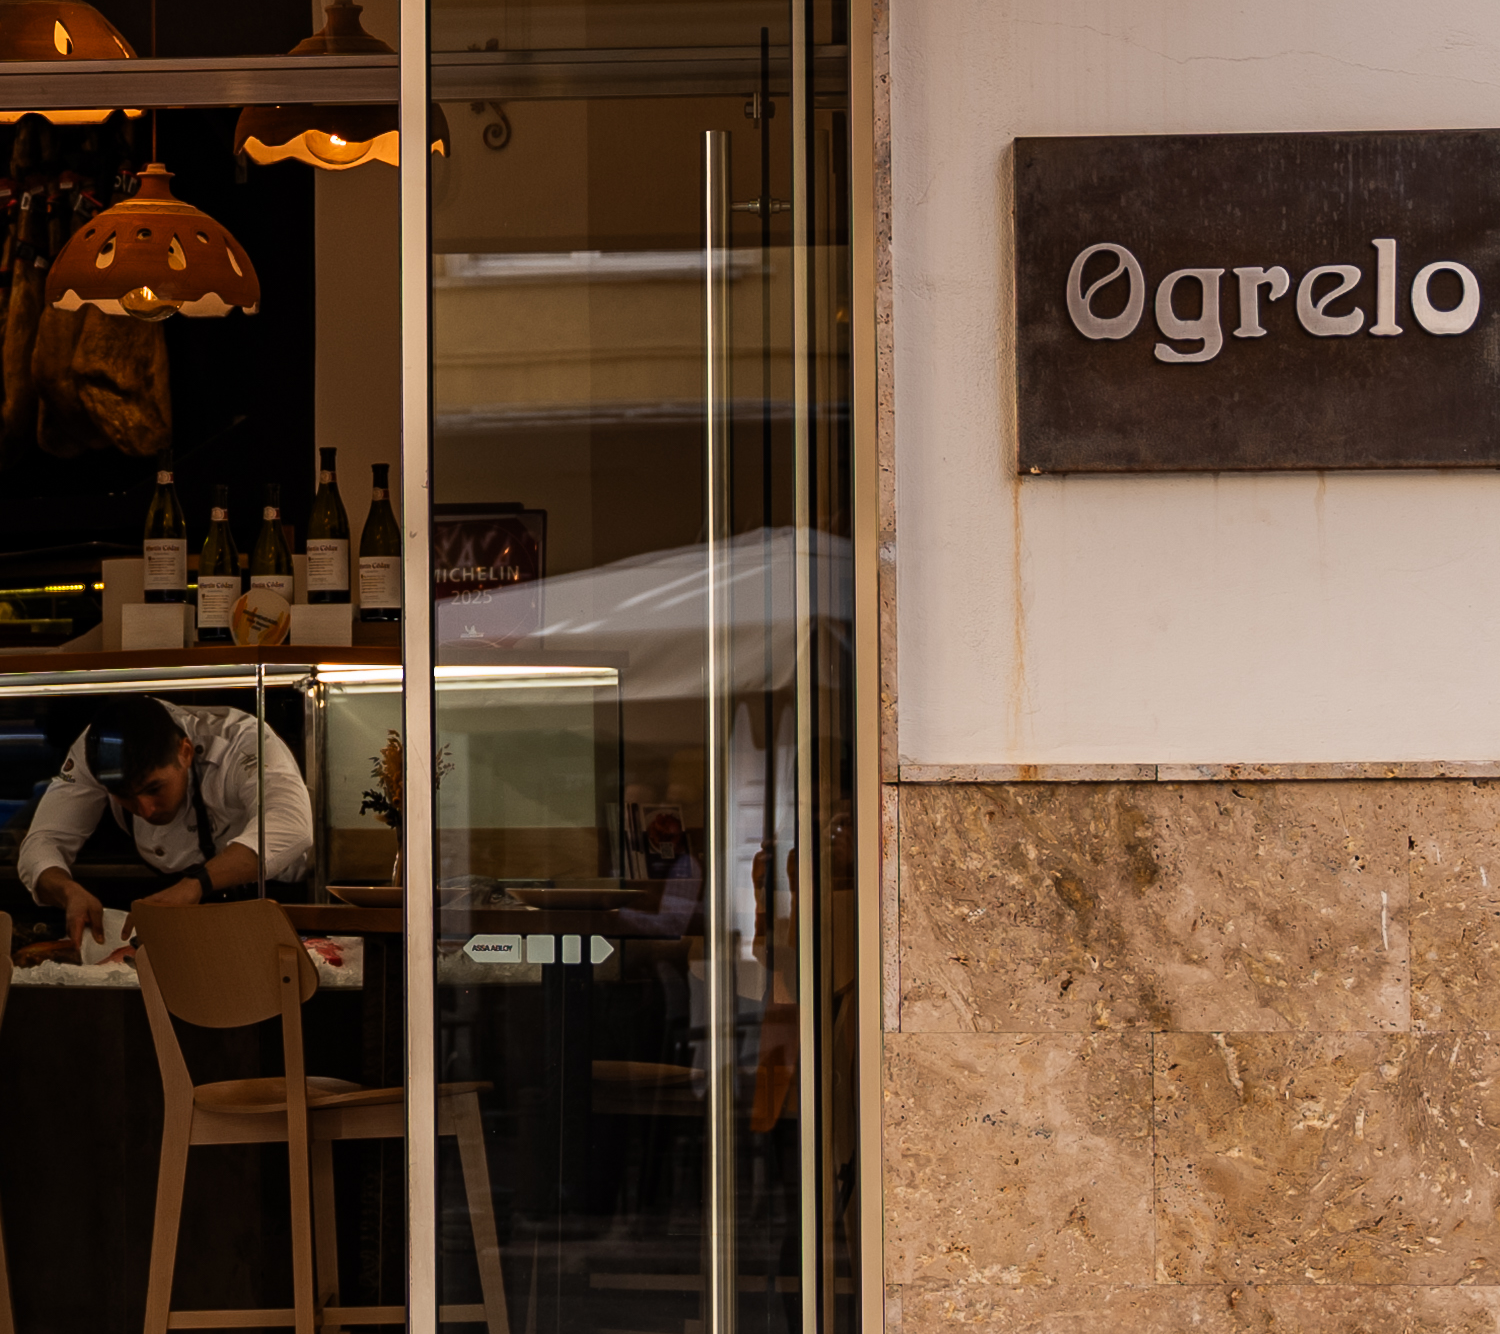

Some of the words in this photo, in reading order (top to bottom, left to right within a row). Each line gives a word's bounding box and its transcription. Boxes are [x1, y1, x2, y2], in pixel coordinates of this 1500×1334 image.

[1065, 238, 1481, 364] Ogrelo
[451, 589, 493, 605] 2025
[471, 944, 490, 952] ASSA
[490, 944, 513, 952] ABLOY
